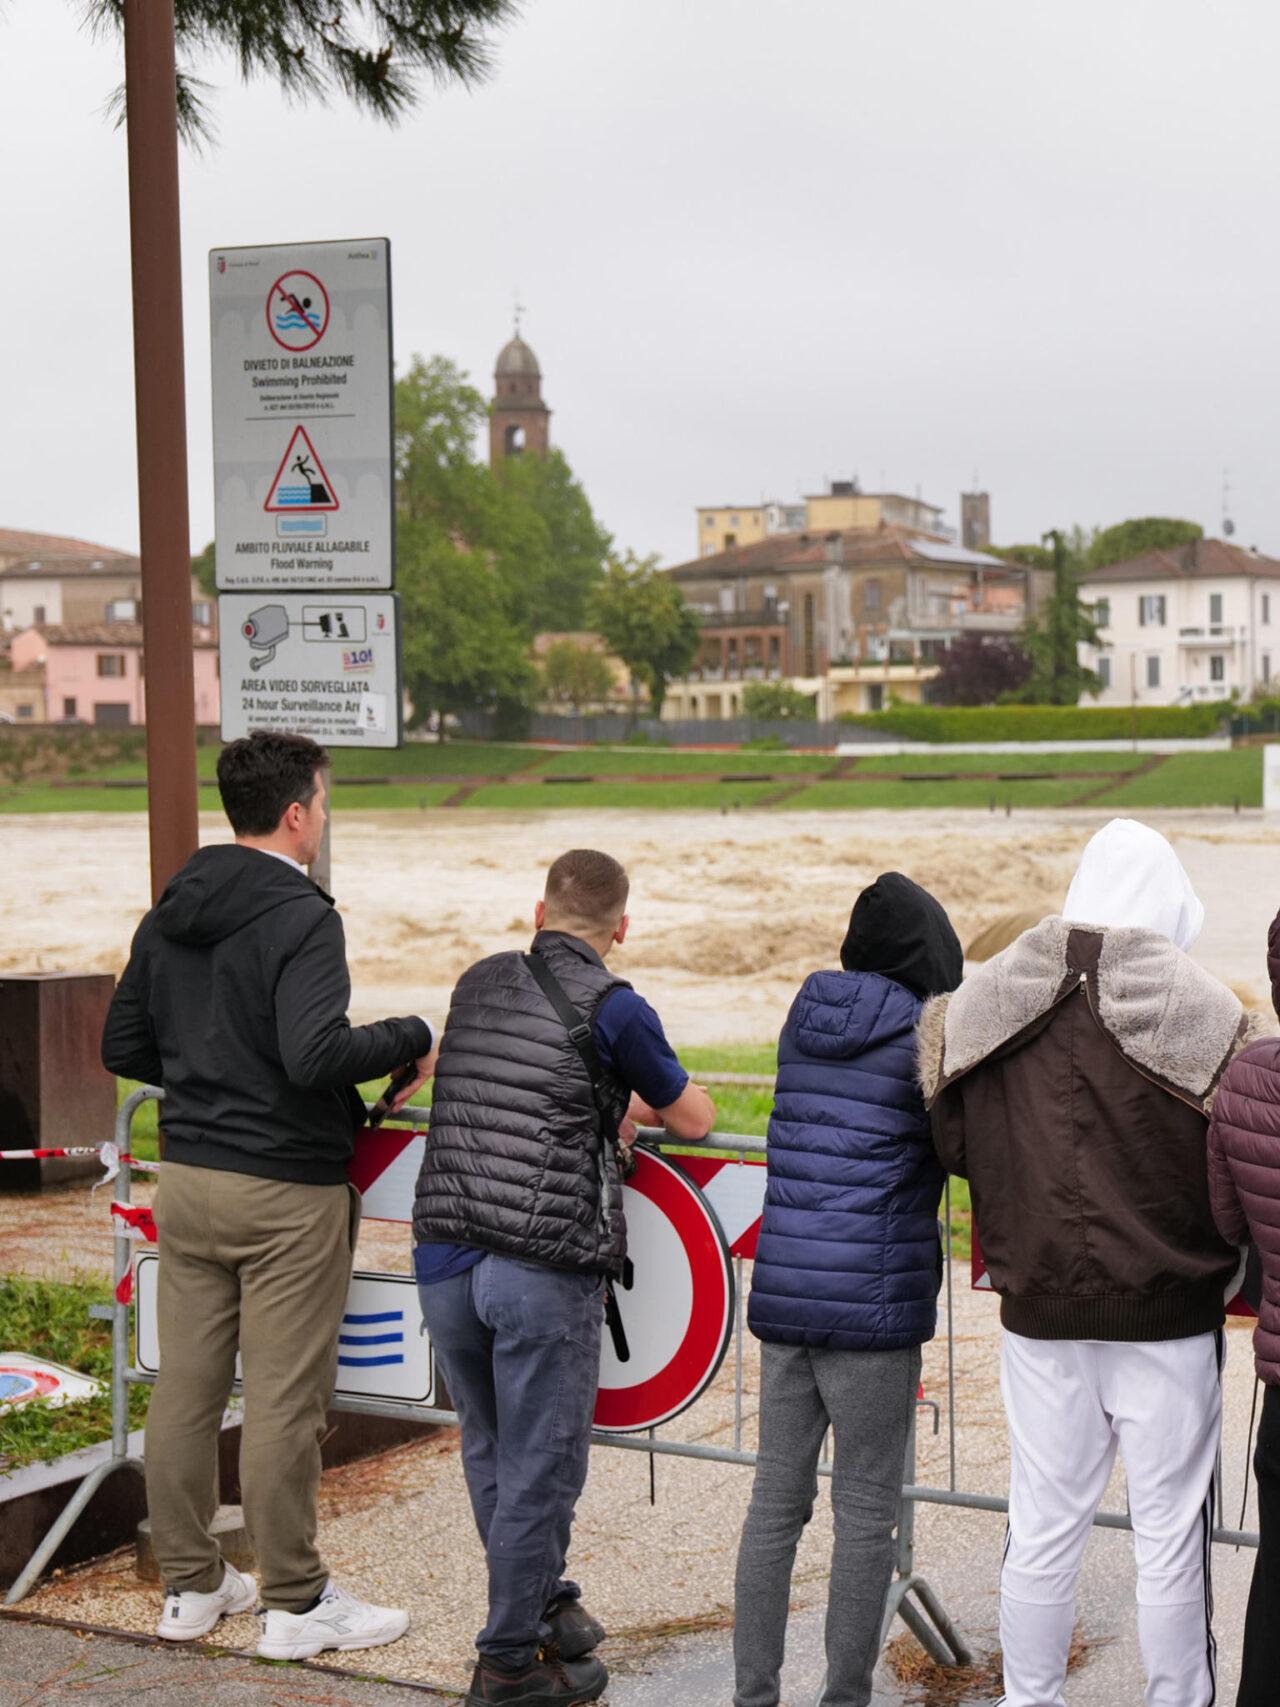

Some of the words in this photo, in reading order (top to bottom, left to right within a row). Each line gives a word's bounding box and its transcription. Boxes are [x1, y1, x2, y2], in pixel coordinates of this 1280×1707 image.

[243, 359, 279, 371] DIVIETO
[280, 358, 290, 370] DI
[292, 355, 355, 369] BALNEAZIONE
[252, 376, 299, 389] Swimming
[301, 373, 347, 386] Prohibited
[235, 542, 270, 554] AMBITO
[272, 541, 313, 554] FLUVIALE
[315, 541, 370, 553] ALLAGABILE
[270, 558, 294, 569] Flood
[296, 558, 334, 571] Warning
[240, 679, 267, 692] AREA
[268, 679, 298, 693] VIDEO
[300, 680, 370, 694] SORVEGLIATA
[242, 697, 254, 710] 24
[256, 697, 278, 711] hour
[280, 697, 342, 712] Surveillance
